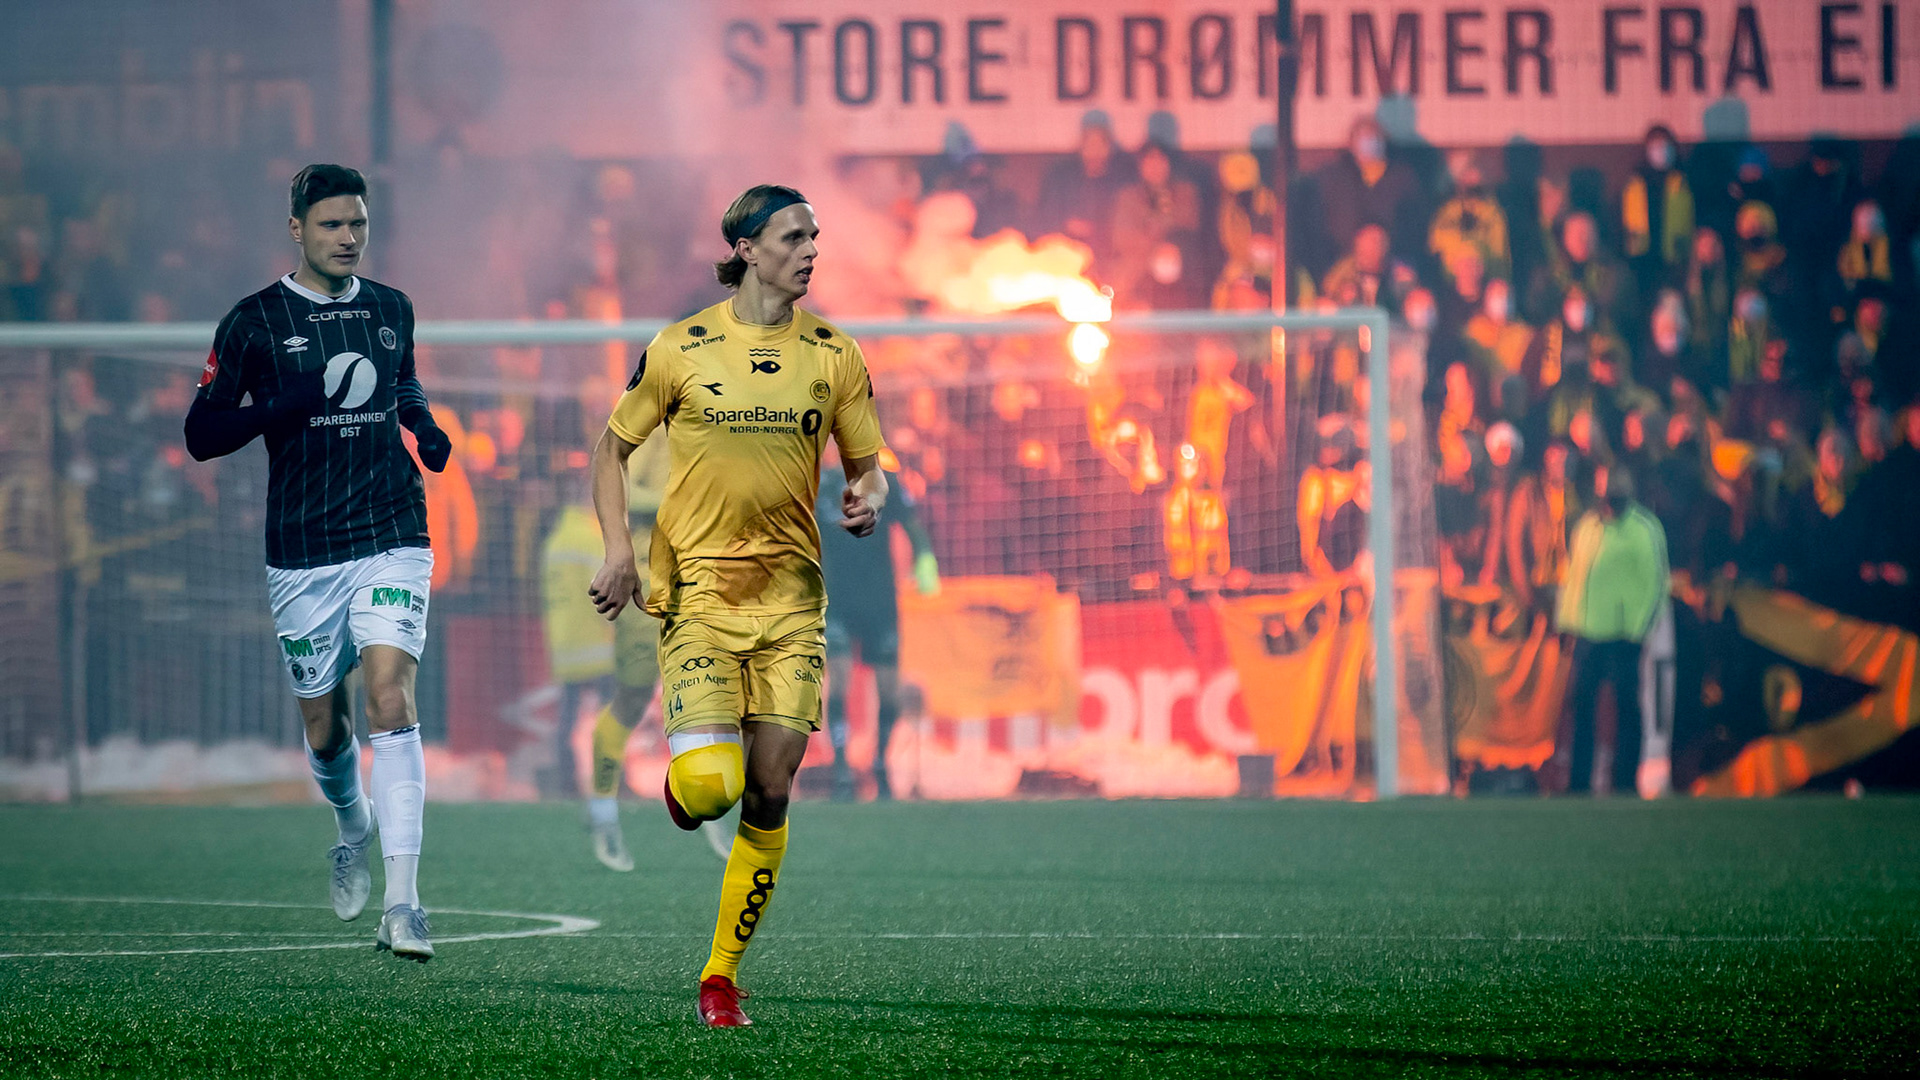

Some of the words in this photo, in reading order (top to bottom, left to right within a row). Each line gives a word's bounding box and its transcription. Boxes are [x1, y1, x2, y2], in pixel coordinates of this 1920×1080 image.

[723, 16, 1007, 106] STORE
[1056, 8, 1554, 102] DRØMMER
[1820, 2, 1897, 89] EI
[310, 411, 387, 427] SPAREBANKEN
[703, 406, 799, 425] SpareBank
[340, 426, 362, 438] ØST
[729, 426, 798, 435] NORD-NORGE
[371, 587, 412, 609] KIWI
[312, 632, 331, 645] mini
[307, 666, 317, 679] 9
[672, 677, 700, 694] Salten
[668, 694, 684, 720] 14
[735, 868, 776, 943] coop
